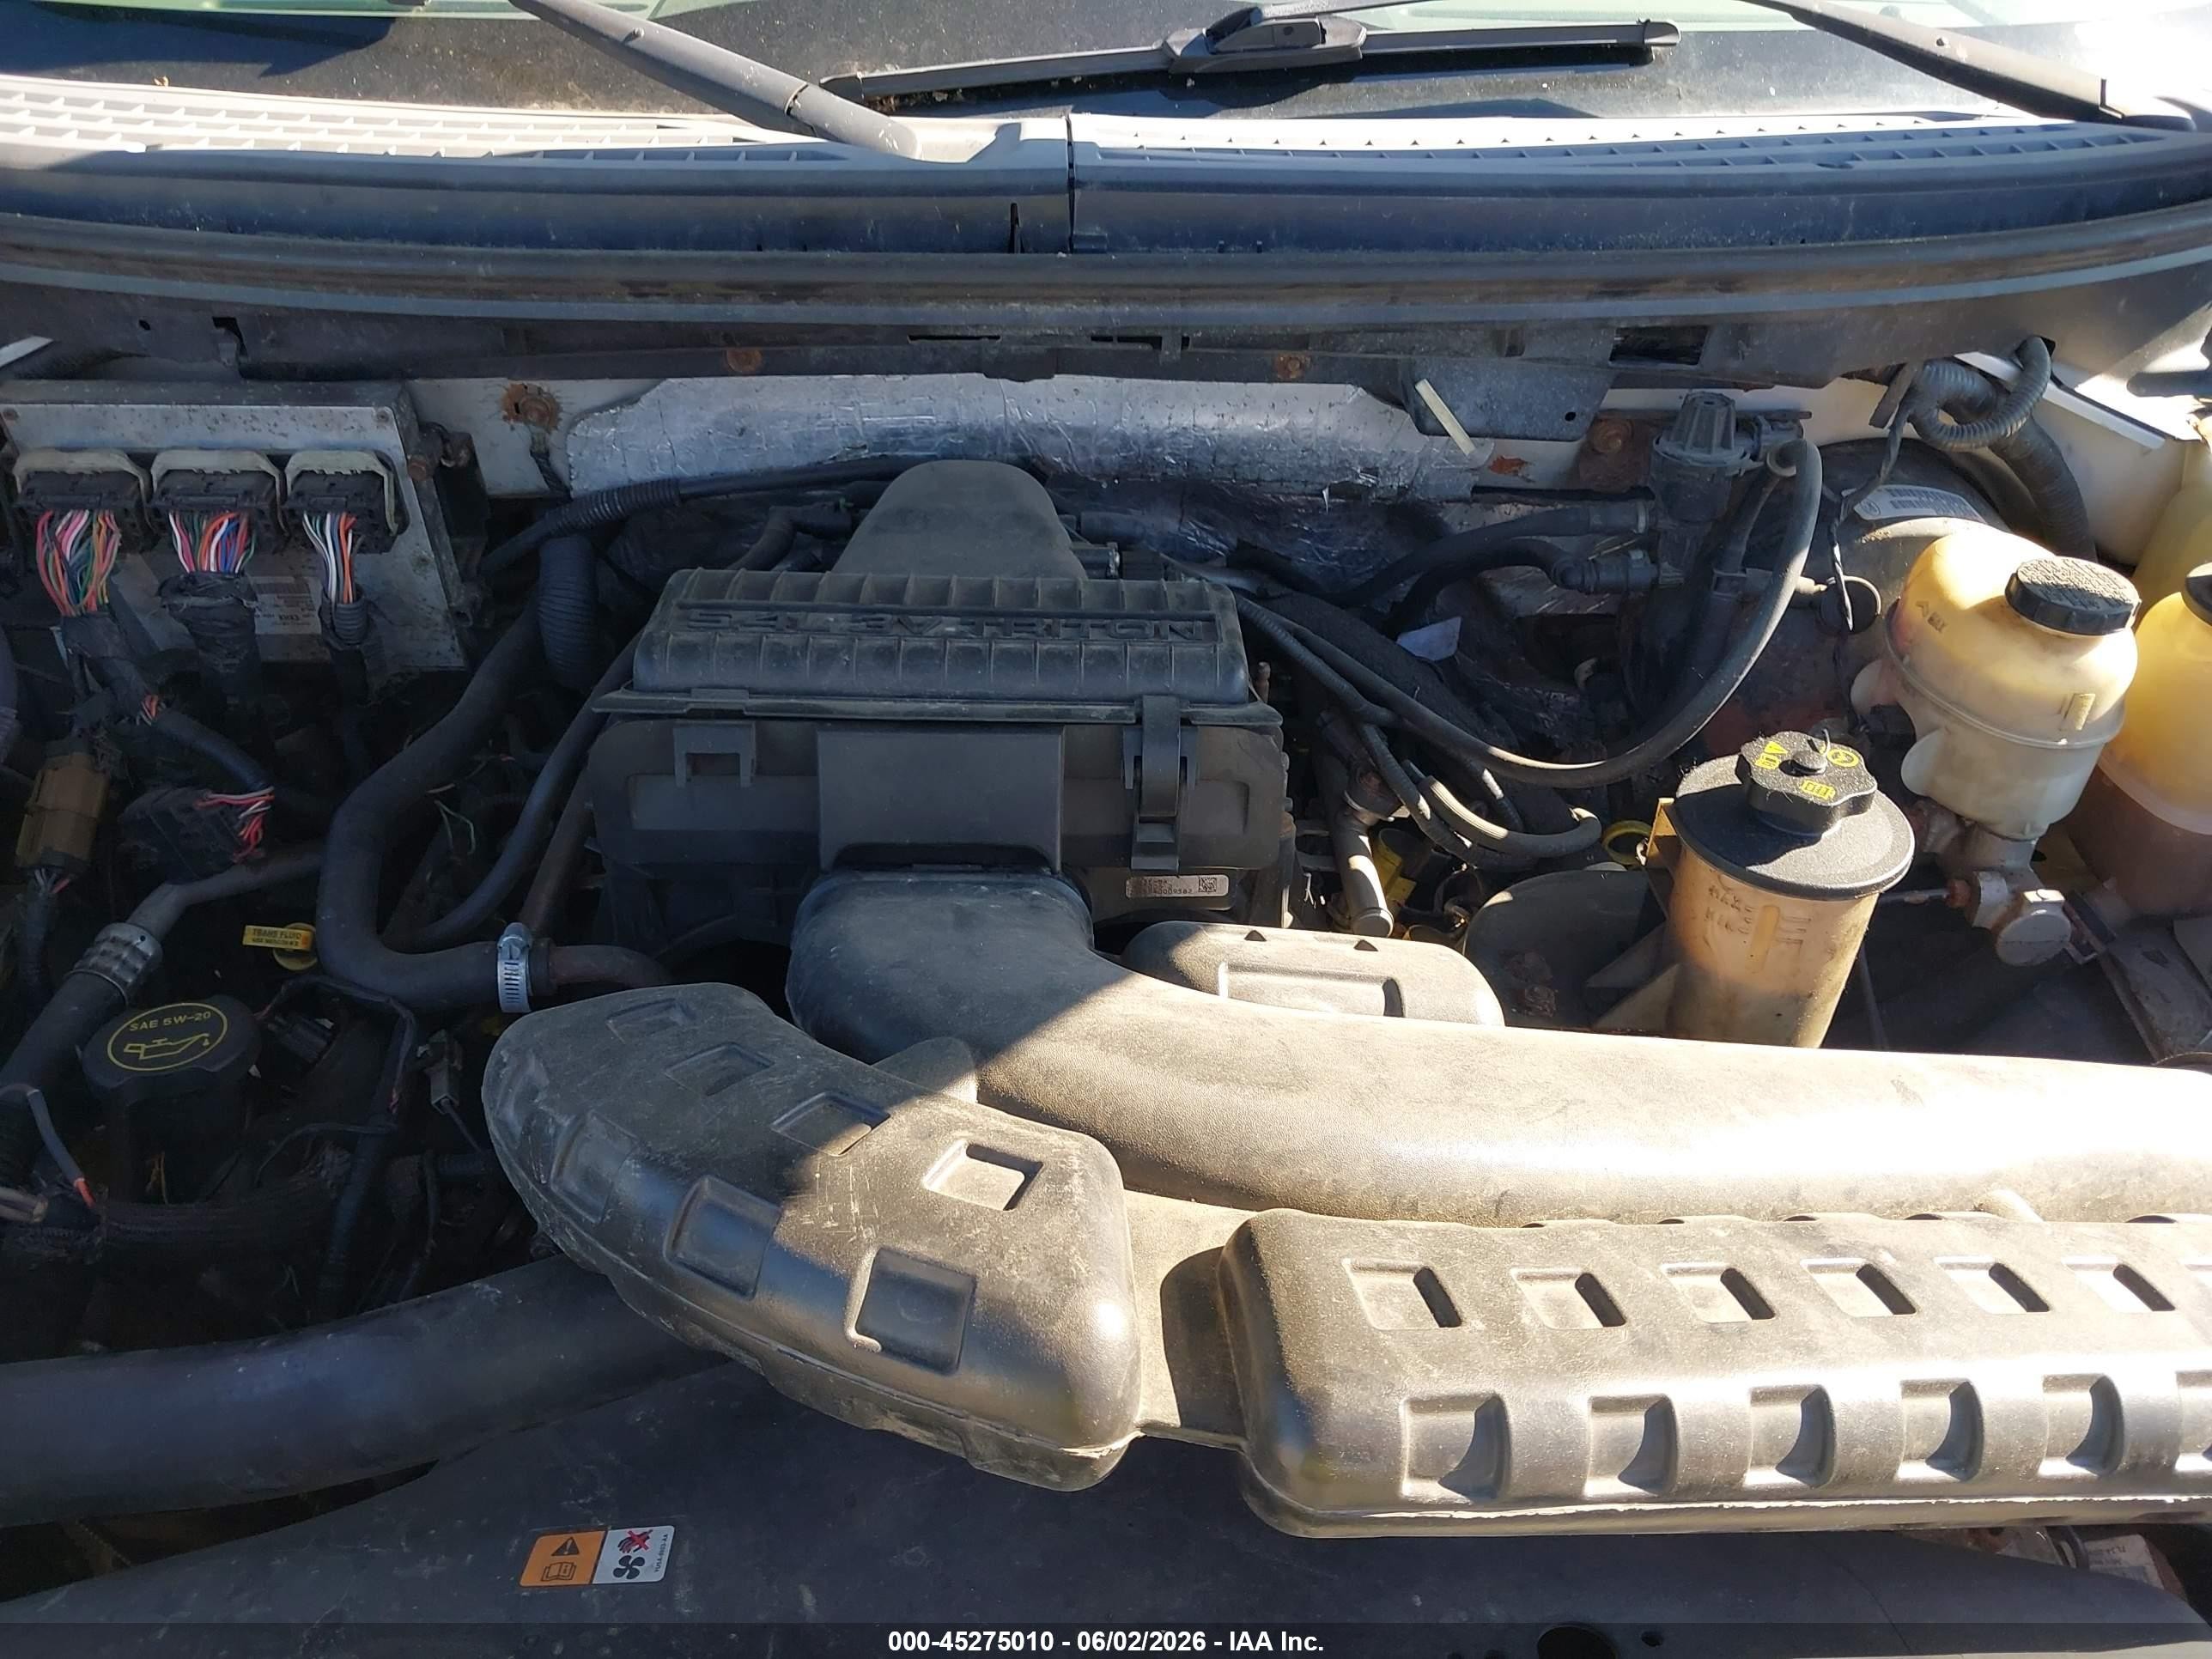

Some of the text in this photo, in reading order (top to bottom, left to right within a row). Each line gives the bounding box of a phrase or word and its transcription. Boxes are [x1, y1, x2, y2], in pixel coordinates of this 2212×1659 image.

[958, 616, 1204, 641] TRITON
[252, 928, 302, 939] TRANS FLUID
[129, 1011, 211, 1031] SAE 5W-20
